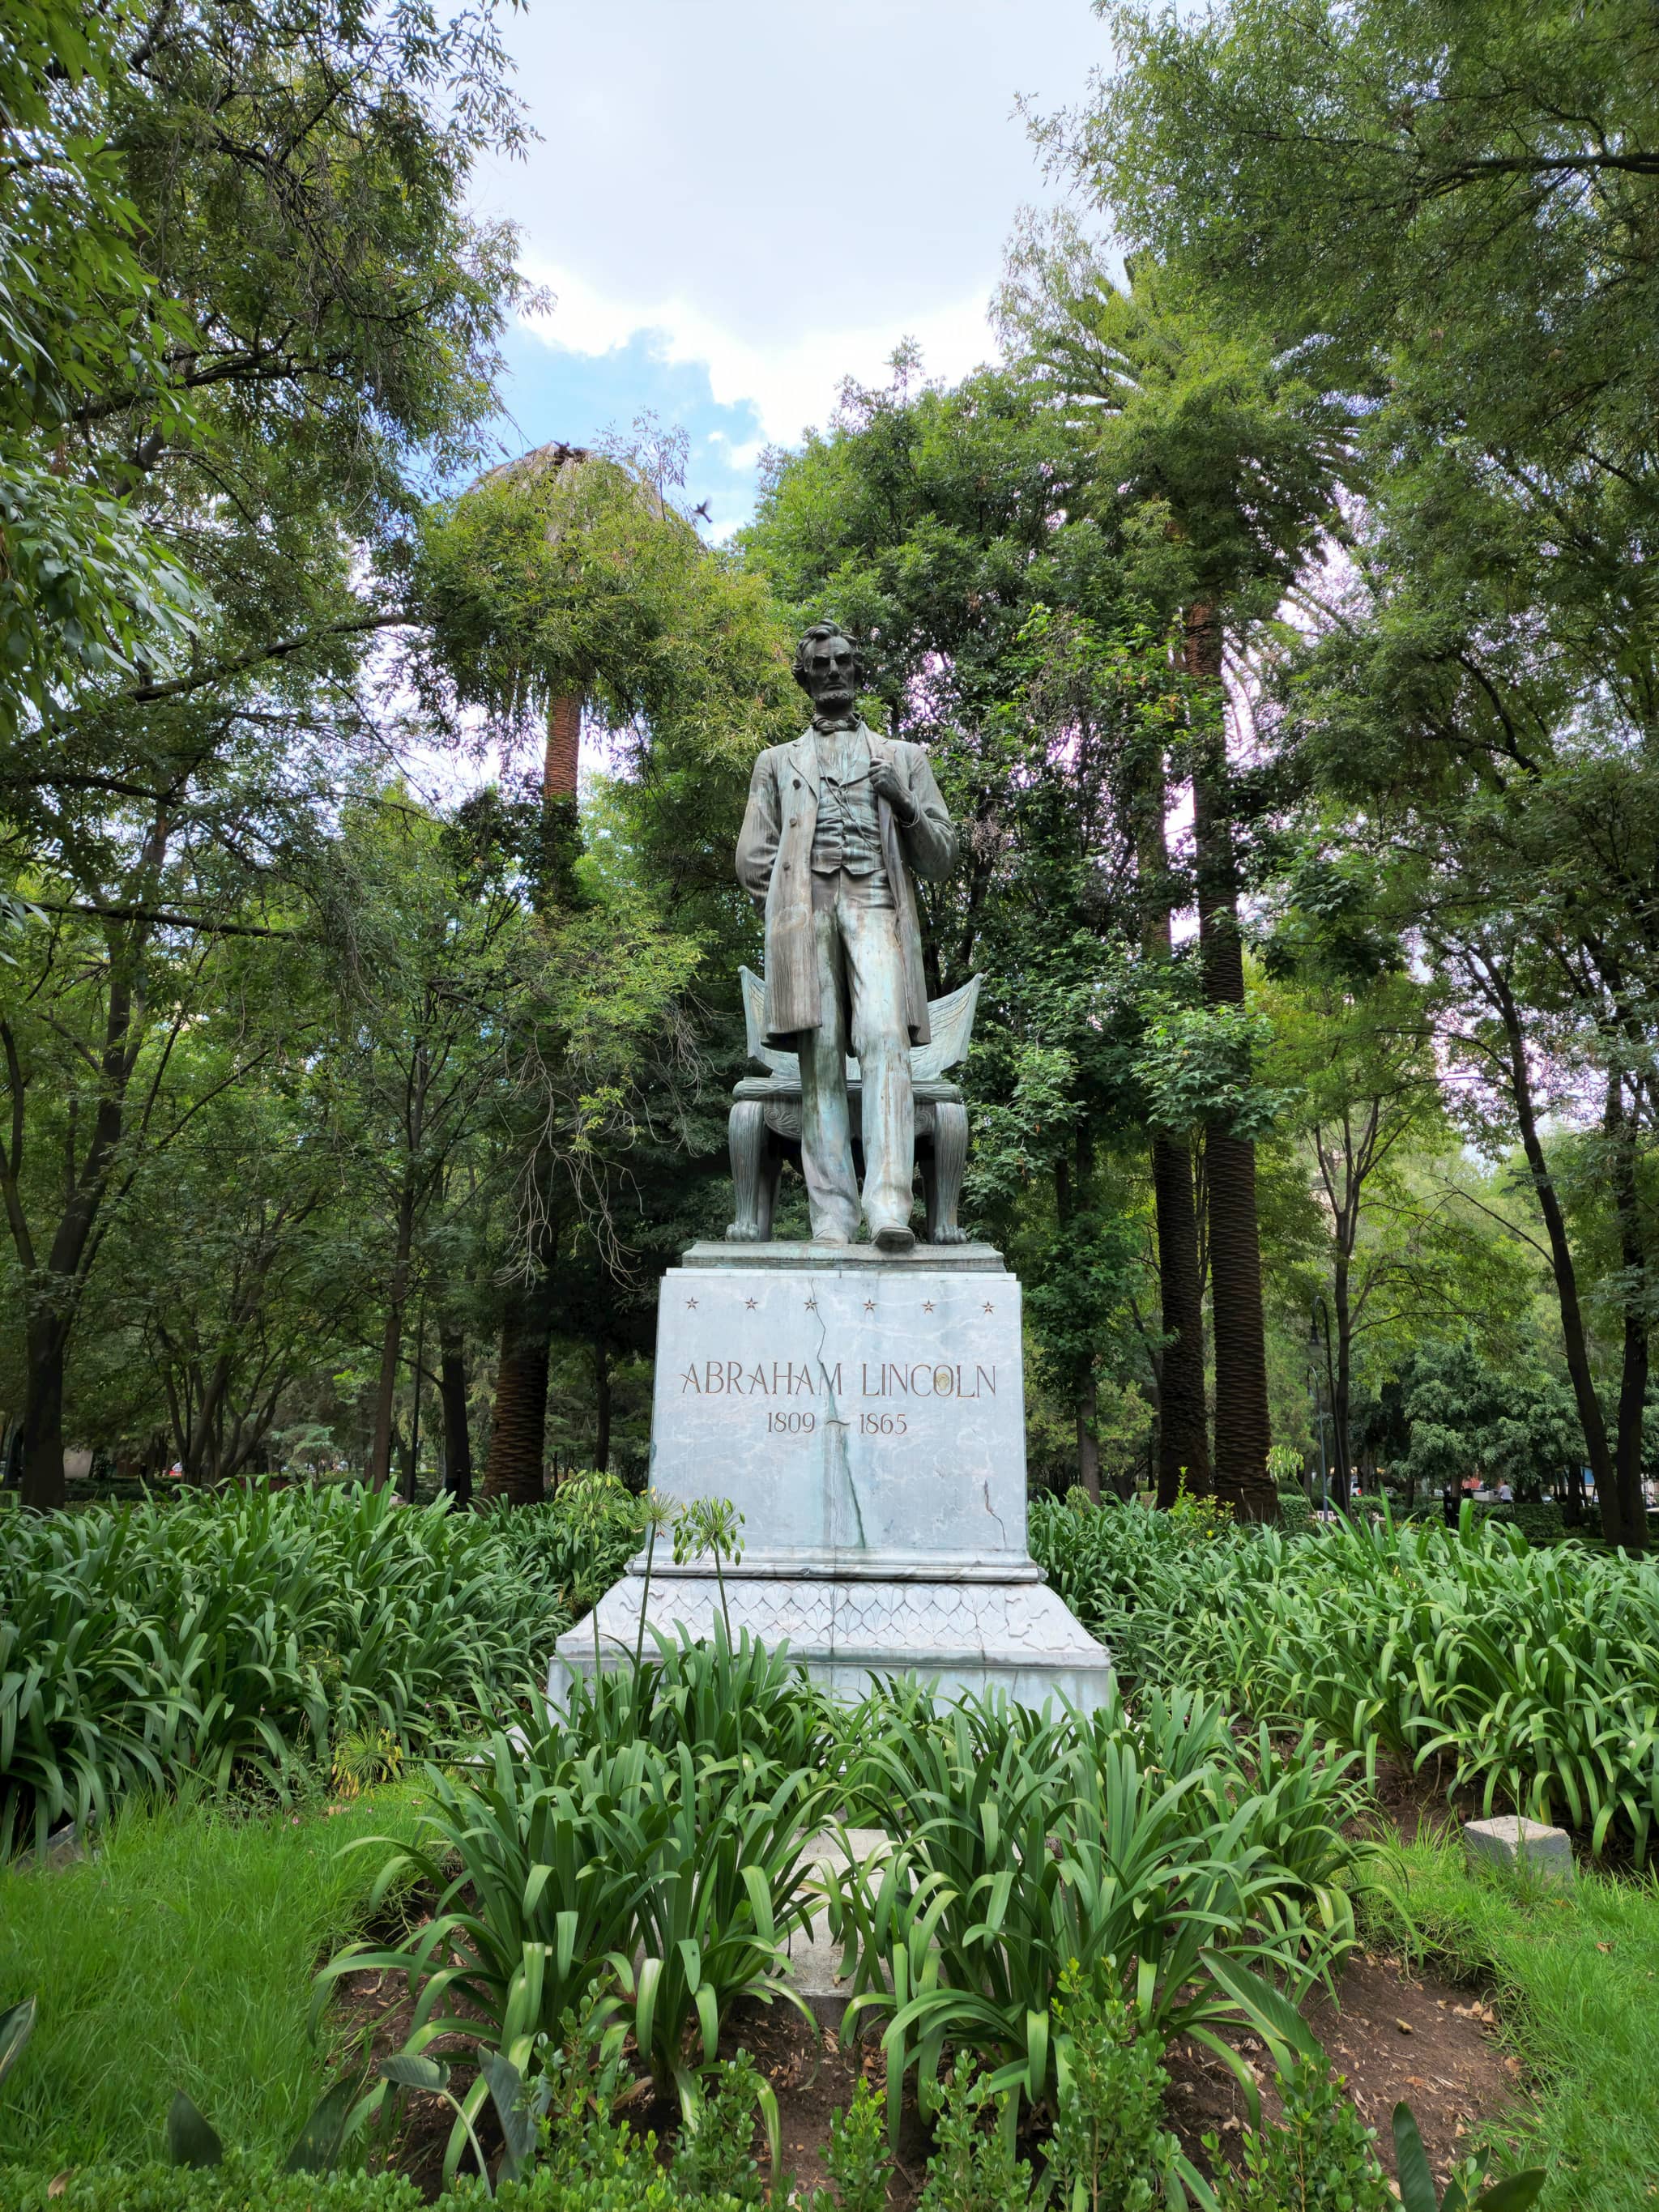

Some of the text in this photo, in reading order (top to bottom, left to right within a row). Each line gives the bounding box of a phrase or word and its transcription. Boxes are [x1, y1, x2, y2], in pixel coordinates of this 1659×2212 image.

[680, 1361, 996, 1398] ABRAHAM LINCOLN
[767, 1412, 816, 1433] 1809
[859, 1413, 907, 1434] 1865
